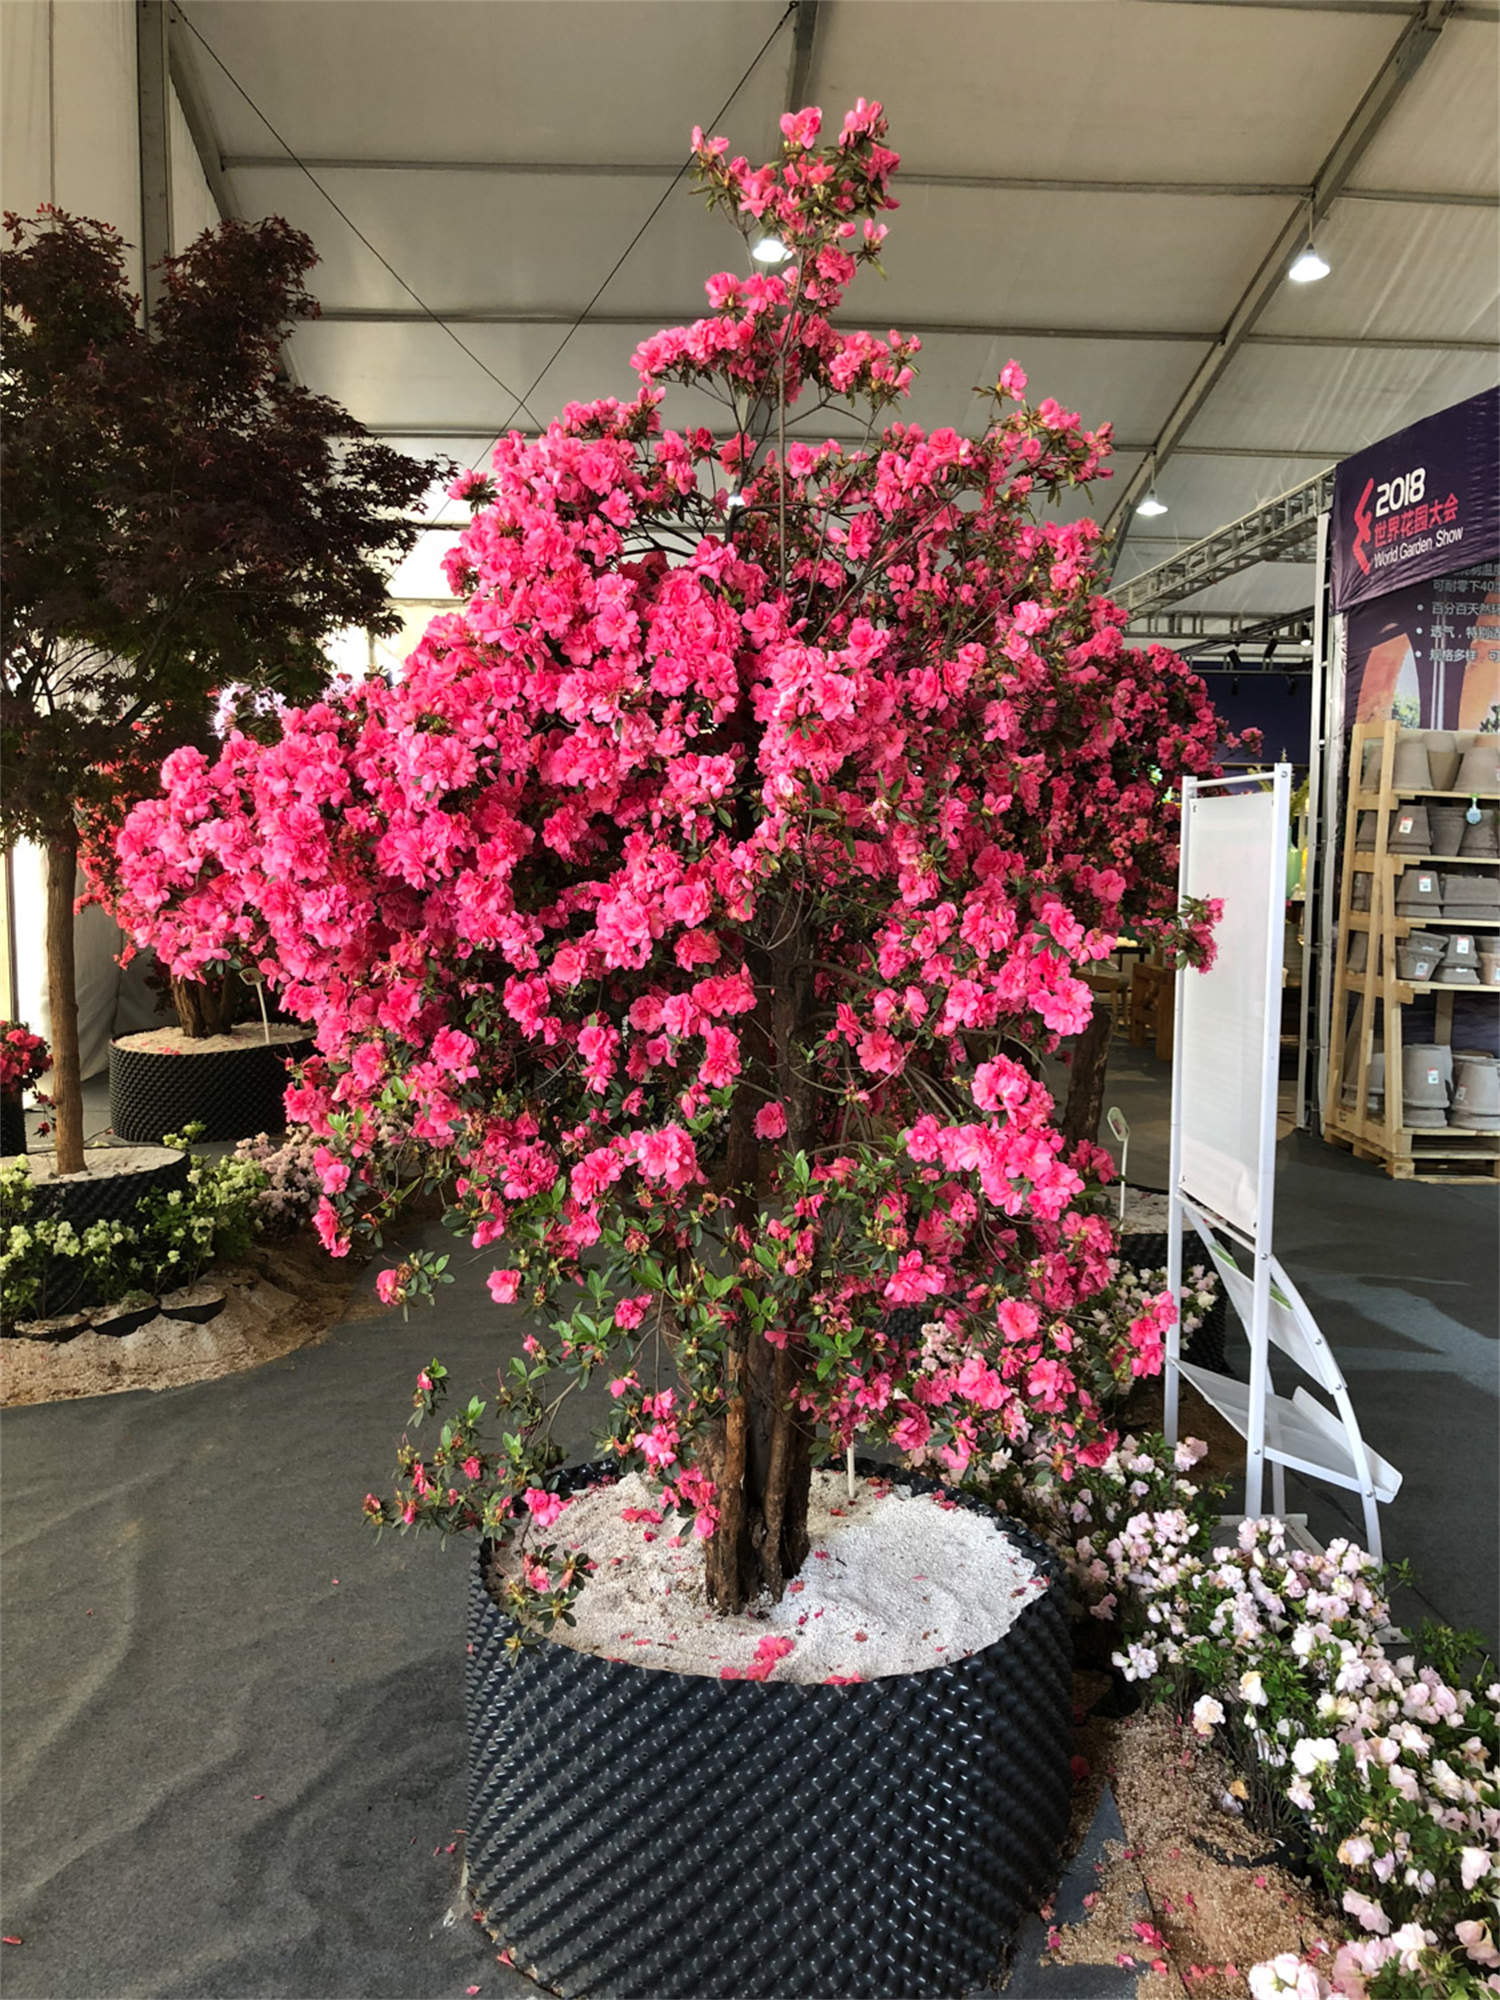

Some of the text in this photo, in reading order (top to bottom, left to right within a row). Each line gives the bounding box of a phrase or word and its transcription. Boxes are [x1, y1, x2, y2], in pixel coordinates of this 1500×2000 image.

[1375, 467, 1426, 517] 2018
[1374, 493, 1459, 548] 世界花园大会
[1374, 526, 1464, 568] World Garden Show
